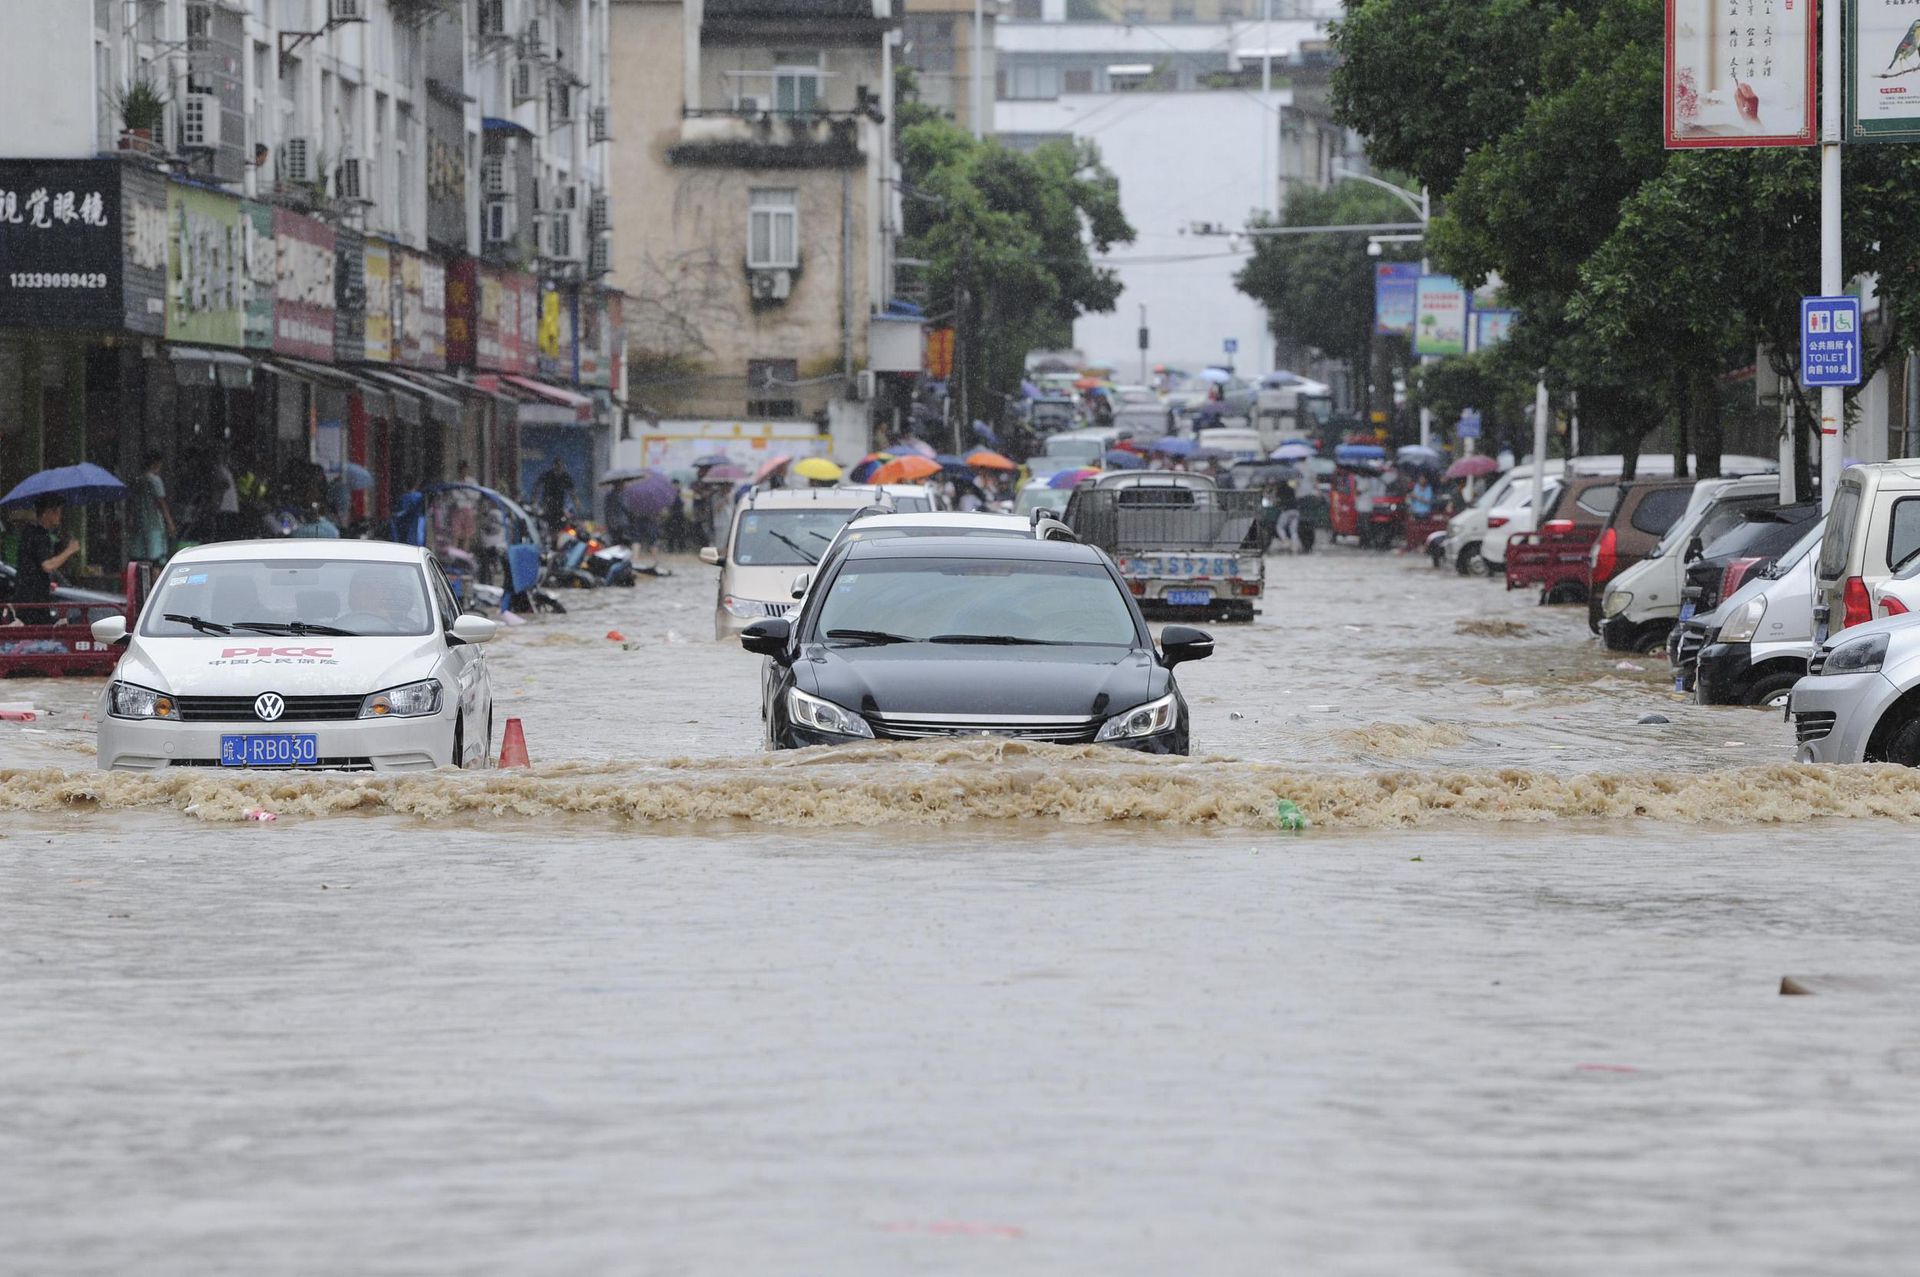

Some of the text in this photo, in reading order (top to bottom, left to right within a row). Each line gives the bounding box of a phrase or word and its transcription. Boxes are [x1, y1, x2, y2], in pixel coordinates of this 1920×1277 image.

[10, 272, 107, 289] 13339099429
[1808, 341, 1845, 351] 公共厕所
[1808, 353, 1845, 363] TOILET
[1825, 365, 1839, 374] 100
[221, 647, 334, 659] PICC
[208, 658, 340, 666] 中国人民保险
